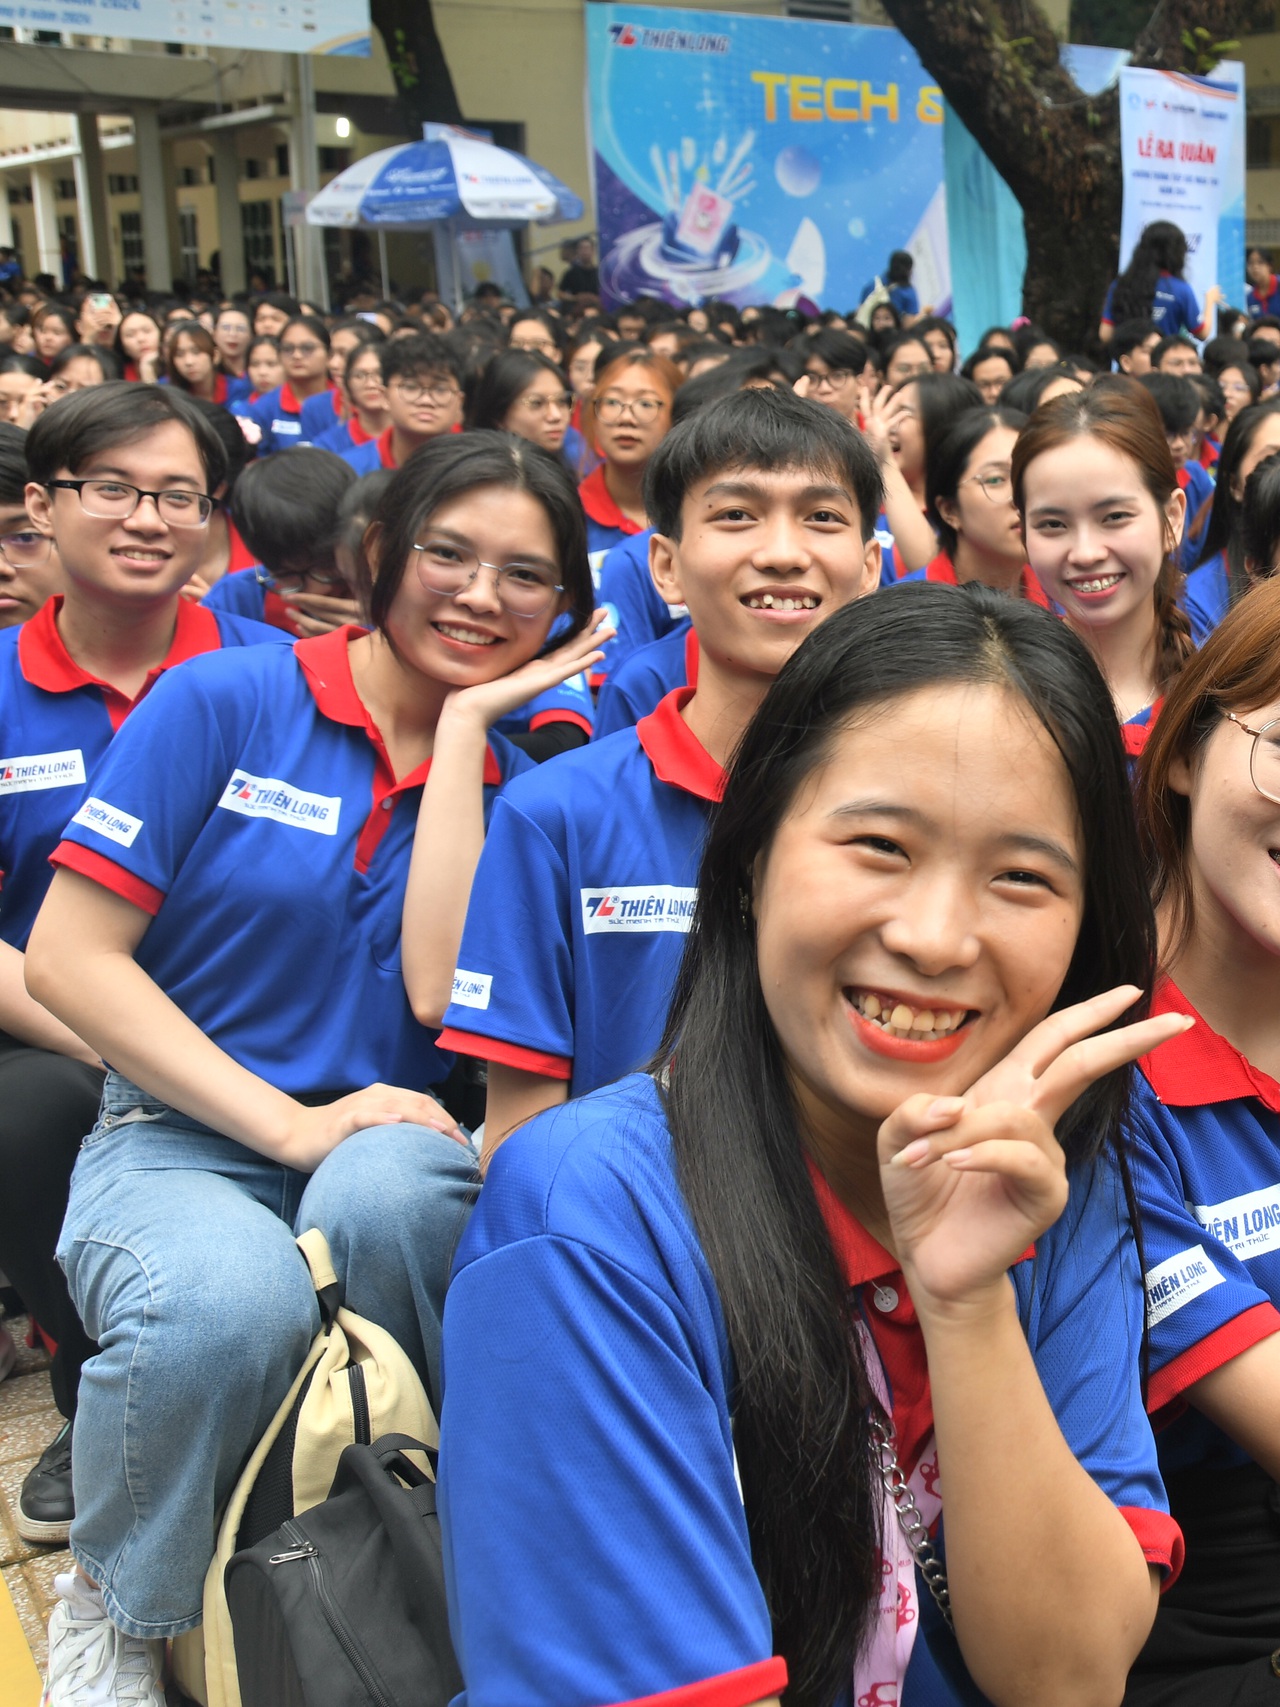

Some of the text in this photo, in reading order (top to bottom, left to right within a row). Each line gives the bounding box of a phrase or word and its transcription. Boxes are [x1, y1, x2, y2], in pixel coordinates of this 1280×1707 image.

[750, 70, 899, 122] TECH
[1157, 139, 1175, 159] RA
[16, 760, 76, 777] THIÊN LONG
[255, 789, 292, 810] THIÊN
[292, 800, 329, 820] LONG
[620, 895, 665, 917] THIÊN
[462, 981, 484, 995] LONG
[1179, 1260, 1208, 1284] LONG
